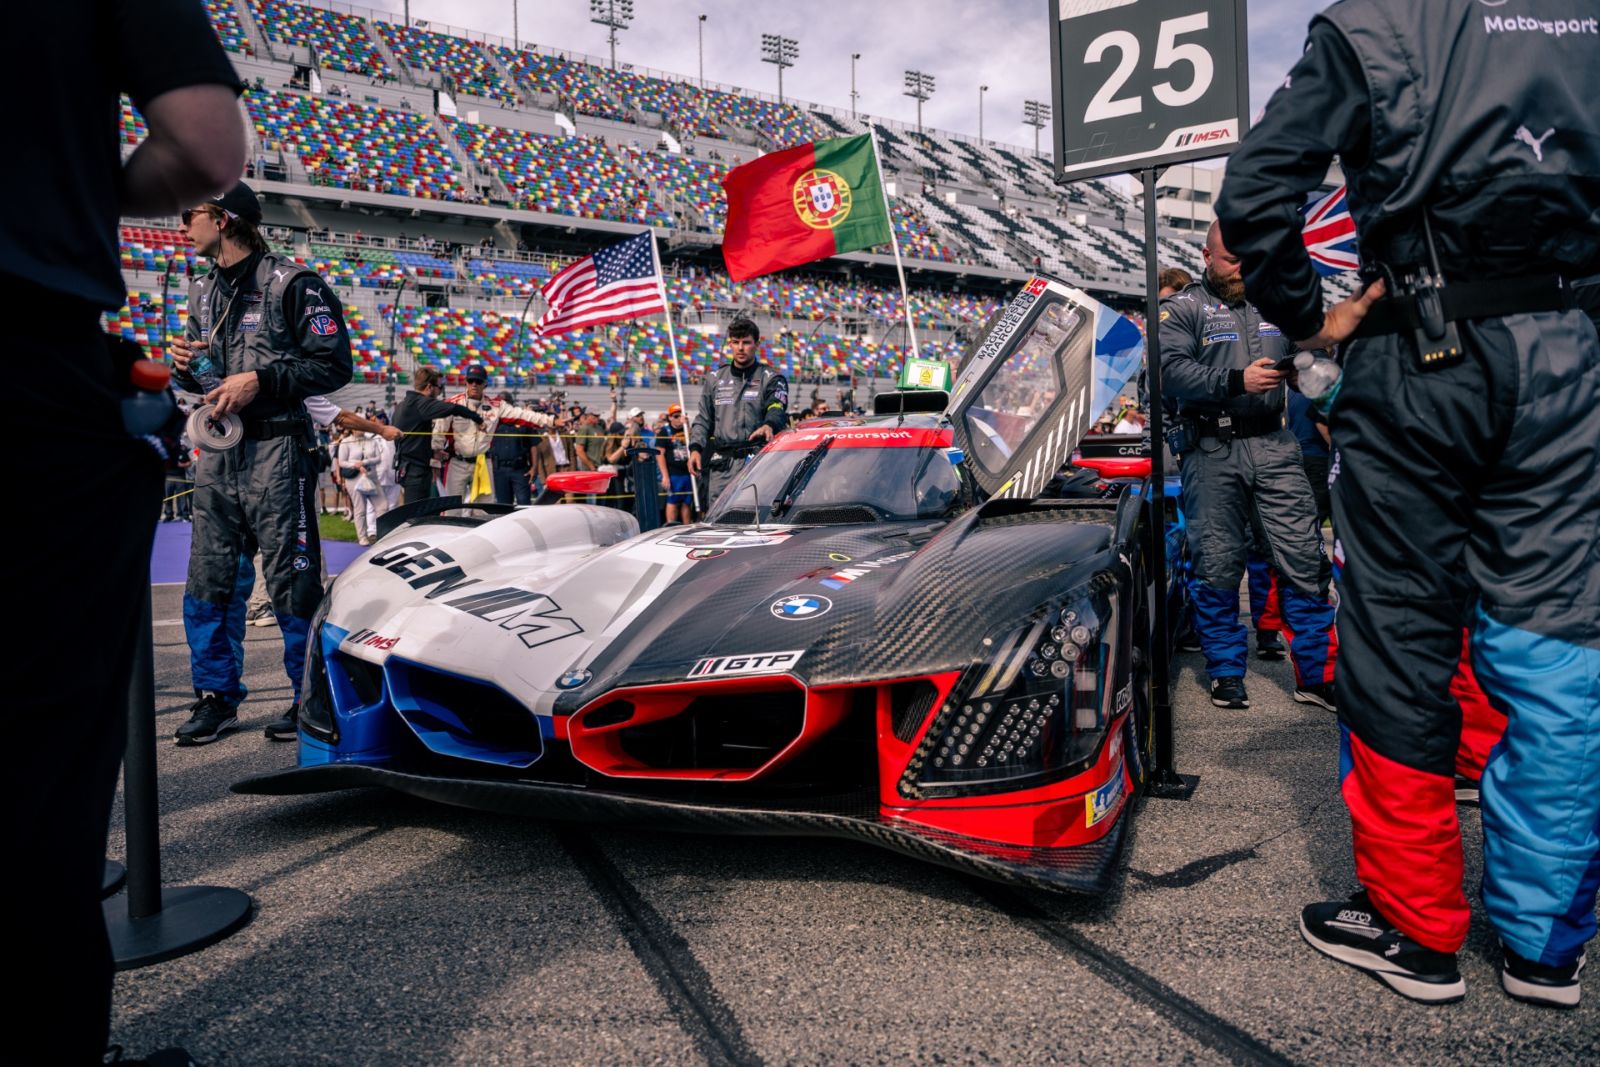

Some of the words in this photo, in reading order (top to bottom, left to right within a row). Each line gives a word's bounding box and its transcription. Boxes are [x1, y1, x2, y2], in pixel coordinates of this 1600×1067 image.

[1484, 14, 1598, 37] Motorsport
[1083, 11, 1214, 124] 25
[1192, 128, 1230, 144] IMSA
[310, 315, 330, 335] VP
[977, 290, 1029, 360] MAGNUSSEN
[986, 295, 1036, 359] MARCIELLO
[822, 430, 912, 440] Motorsport
[369, 541, 483, 599] GEN
[724, 654, 795, 671] GTP
